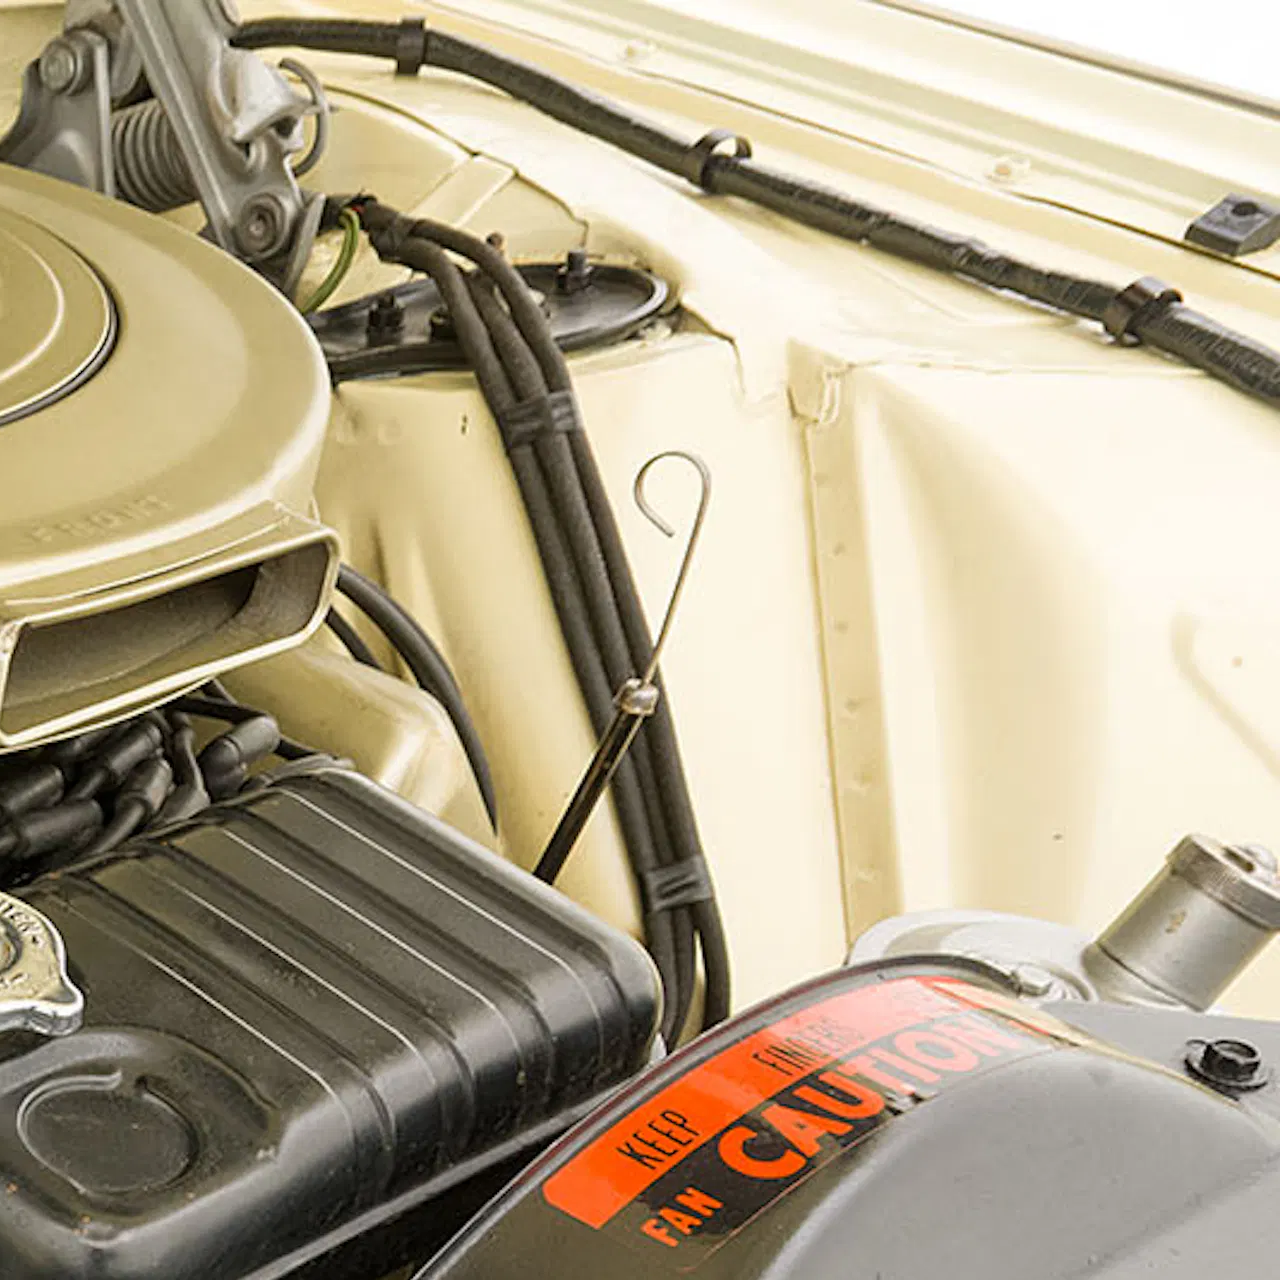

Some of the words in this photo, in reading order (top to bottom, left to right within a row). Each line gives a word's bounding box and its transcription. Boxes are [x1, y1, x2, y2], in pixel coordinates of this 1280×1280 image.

[616, 1109, 702, 1171] KEEP
[641, 1184, 723, 1248] FAN
[718, 1009, 1024, 1181] CAUTION
